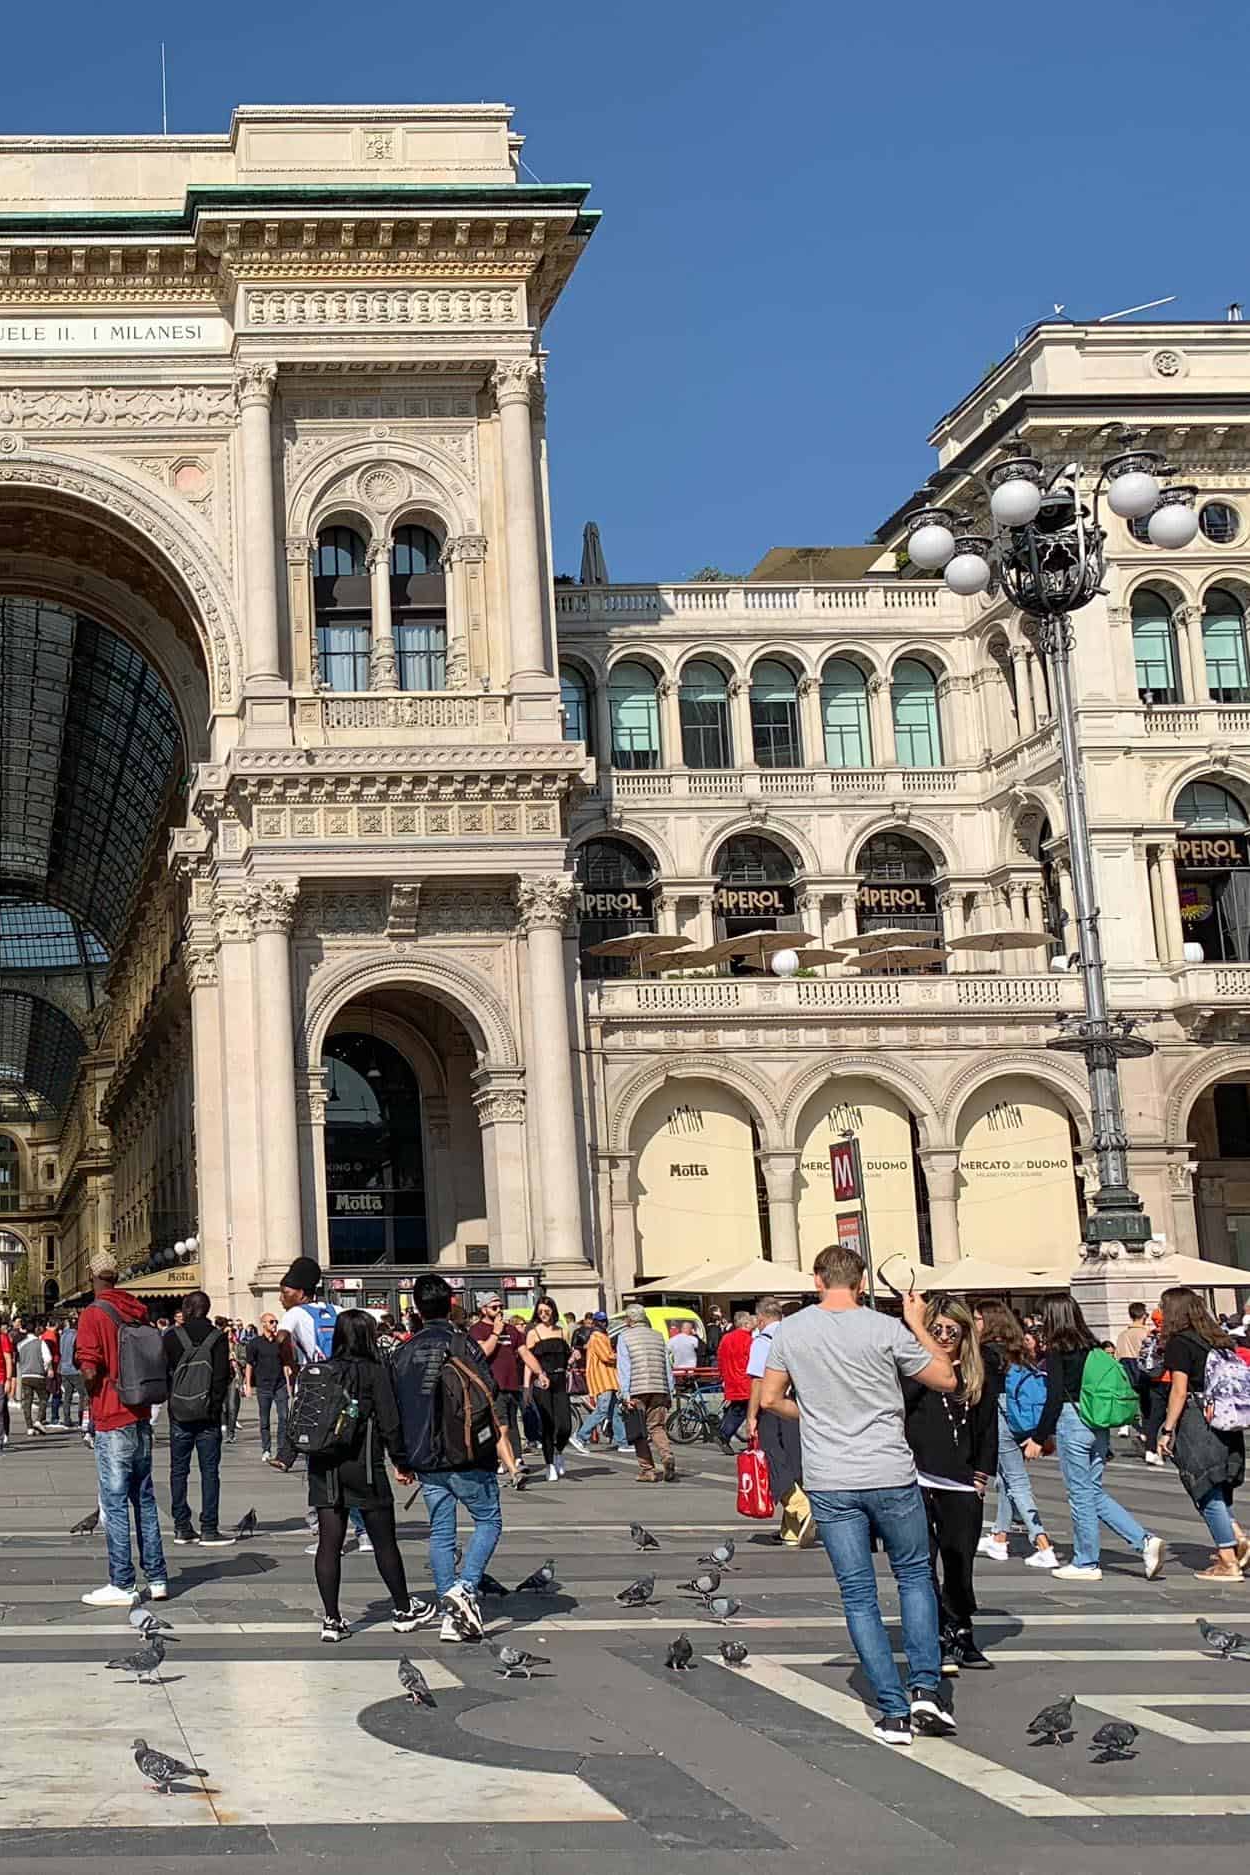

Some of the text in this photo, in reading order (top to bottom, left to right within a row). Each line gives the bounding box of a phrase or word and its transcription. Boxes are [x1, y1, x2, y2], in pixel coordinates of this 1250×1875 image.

[110, 326, 202, 341] MILANESI
[716, 888, 784, 909] APEROL
[857, 887, 927, 907] APEROL
[669, 1163, 710, 1177] Motta
[801, 1161, 908, 1170] MERC DUOMO
[833, 1154, 855, 1190] M
[960, 1161, 1011, 1170] MERCATO
[1026, 1160, 1068, 1169] DUOMO
[334, 1193, 383, 1211] Motta
[167, 1271, 196, 1282] Motta
